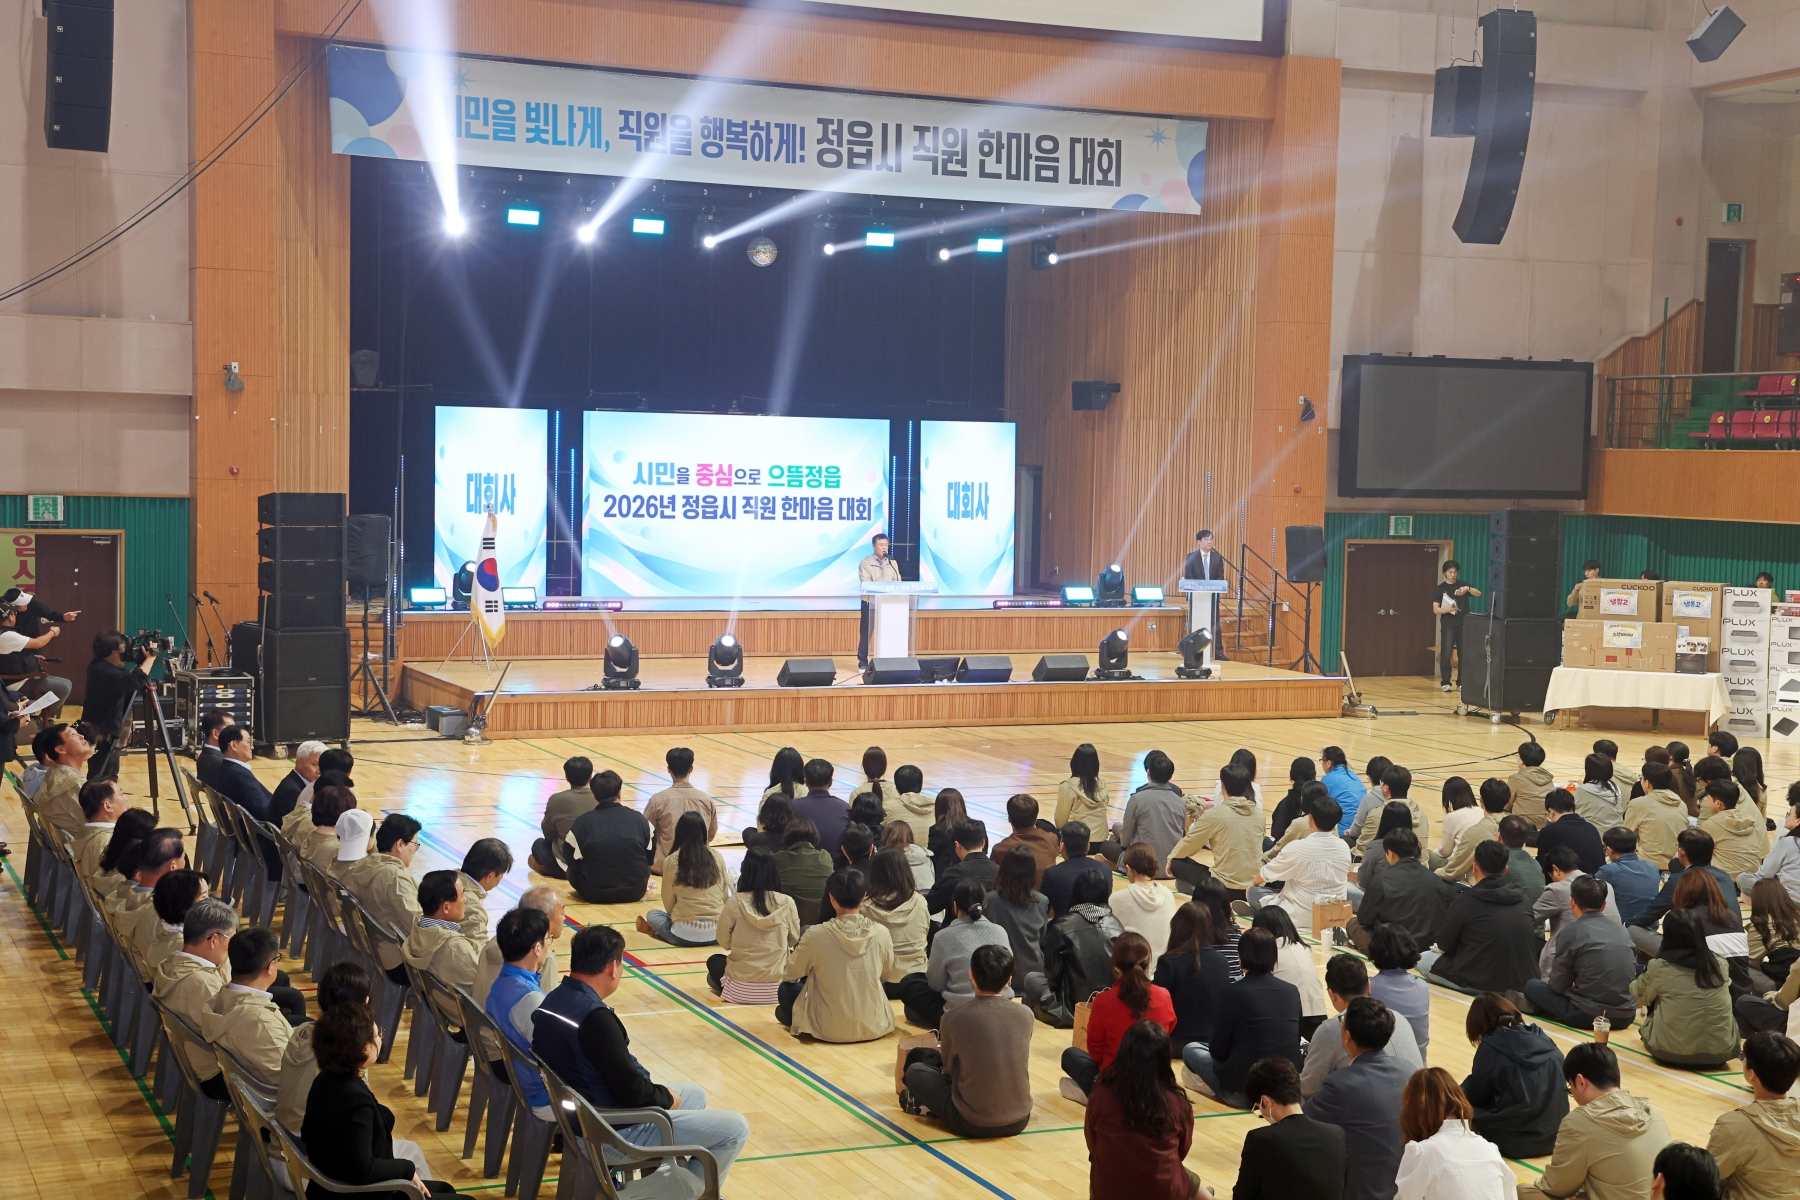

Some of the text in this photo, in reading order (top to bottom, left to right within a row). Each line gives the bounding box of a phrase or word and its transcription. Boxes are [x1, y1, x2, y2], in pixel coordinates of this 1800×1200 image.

[525, 101, 610, 153] 빛나게,
[618, 109, 692, 156] 직원을
[700, 115, 806, 164] 행복하게!
[816, 117, 902, 173] 정읍시
[913, 125, 968, 177] 직원
[977, 128, 1059, 184] 한마음
[1069, 136, 1122, 187] 대회
[632, 461, 842, 489] 시민을 중심으로 으뜸정읍
[466, 472, 516, 515] 대회사
[947, 481, 989, 520] 대회사
[603, 494, 872, 521] 2026년 정읍시 직원 한마음 대회
[1724, 588, 1758, 597] PLUX
[1722, 618, 1756, 626] PLUX
[1722, 648, 1755, 656] PLUX
